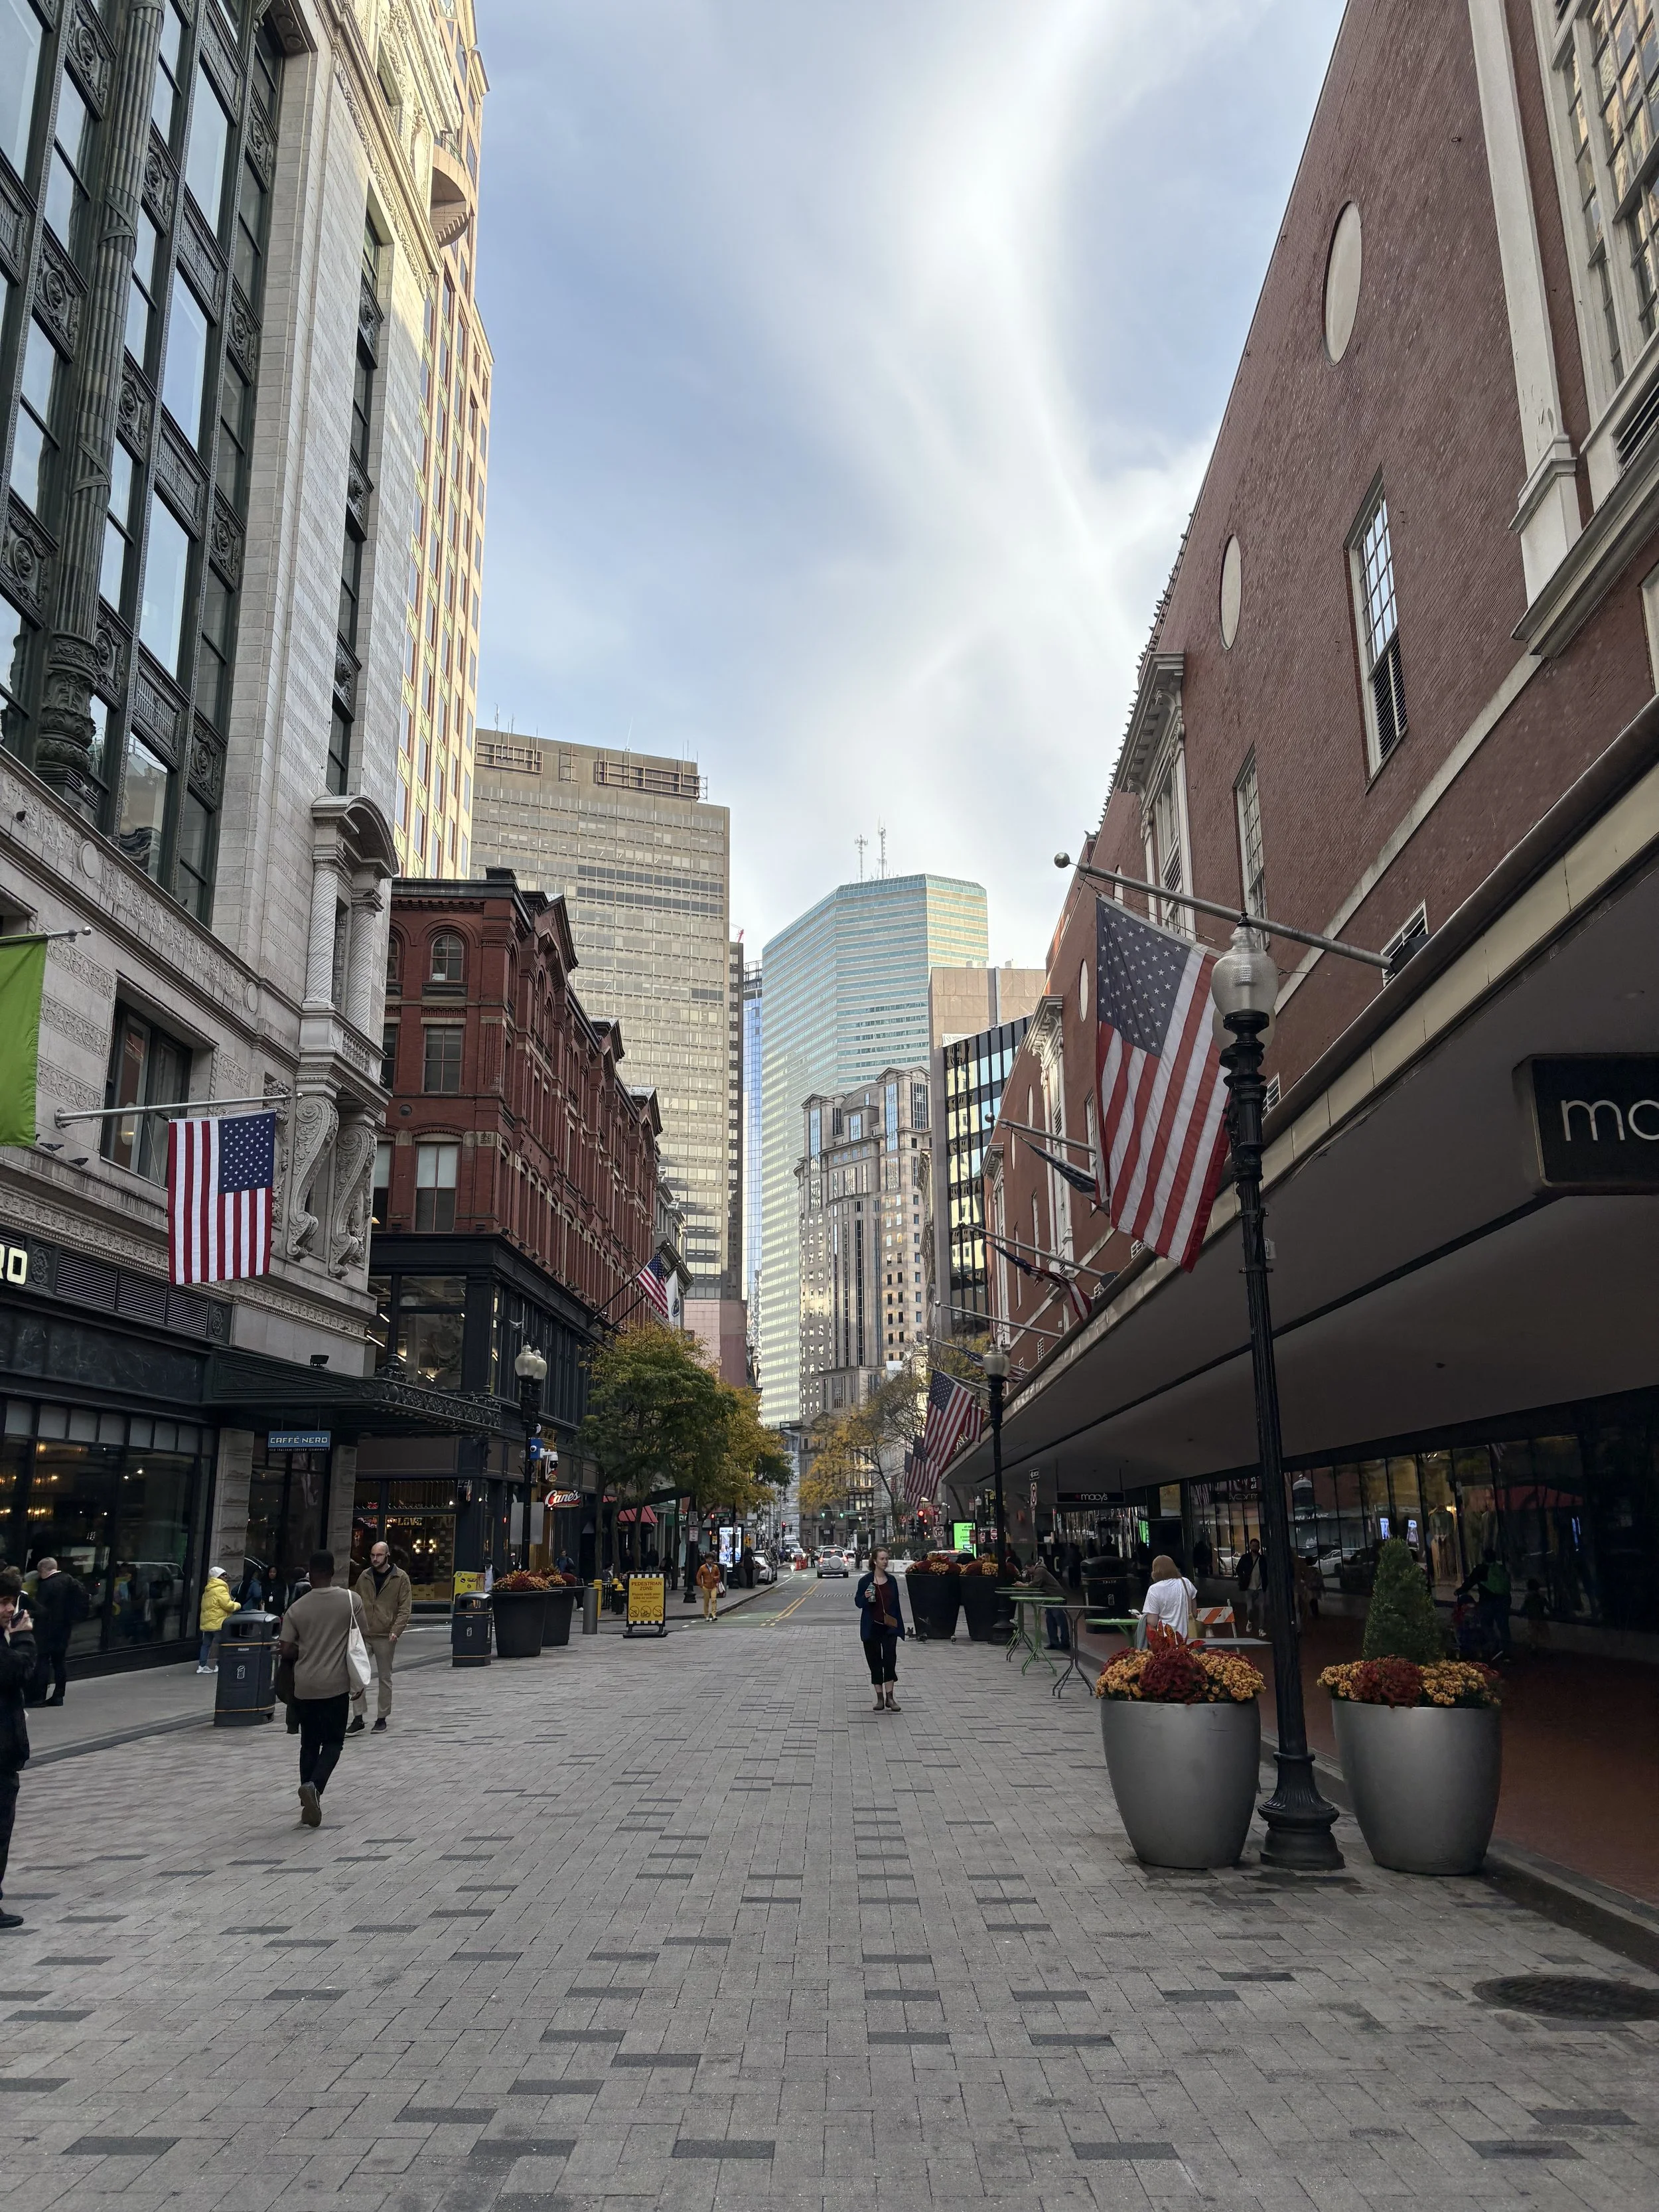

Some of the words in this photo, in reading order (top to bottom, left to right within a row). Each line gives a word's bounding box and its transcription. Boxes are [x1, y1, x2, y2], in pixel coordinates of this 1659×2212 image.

[545, 1490, 580, 1507] Cane's
[1081, 1493, 1108, 1502] macy's
[398, 1517, 422, 1526] LOVE
